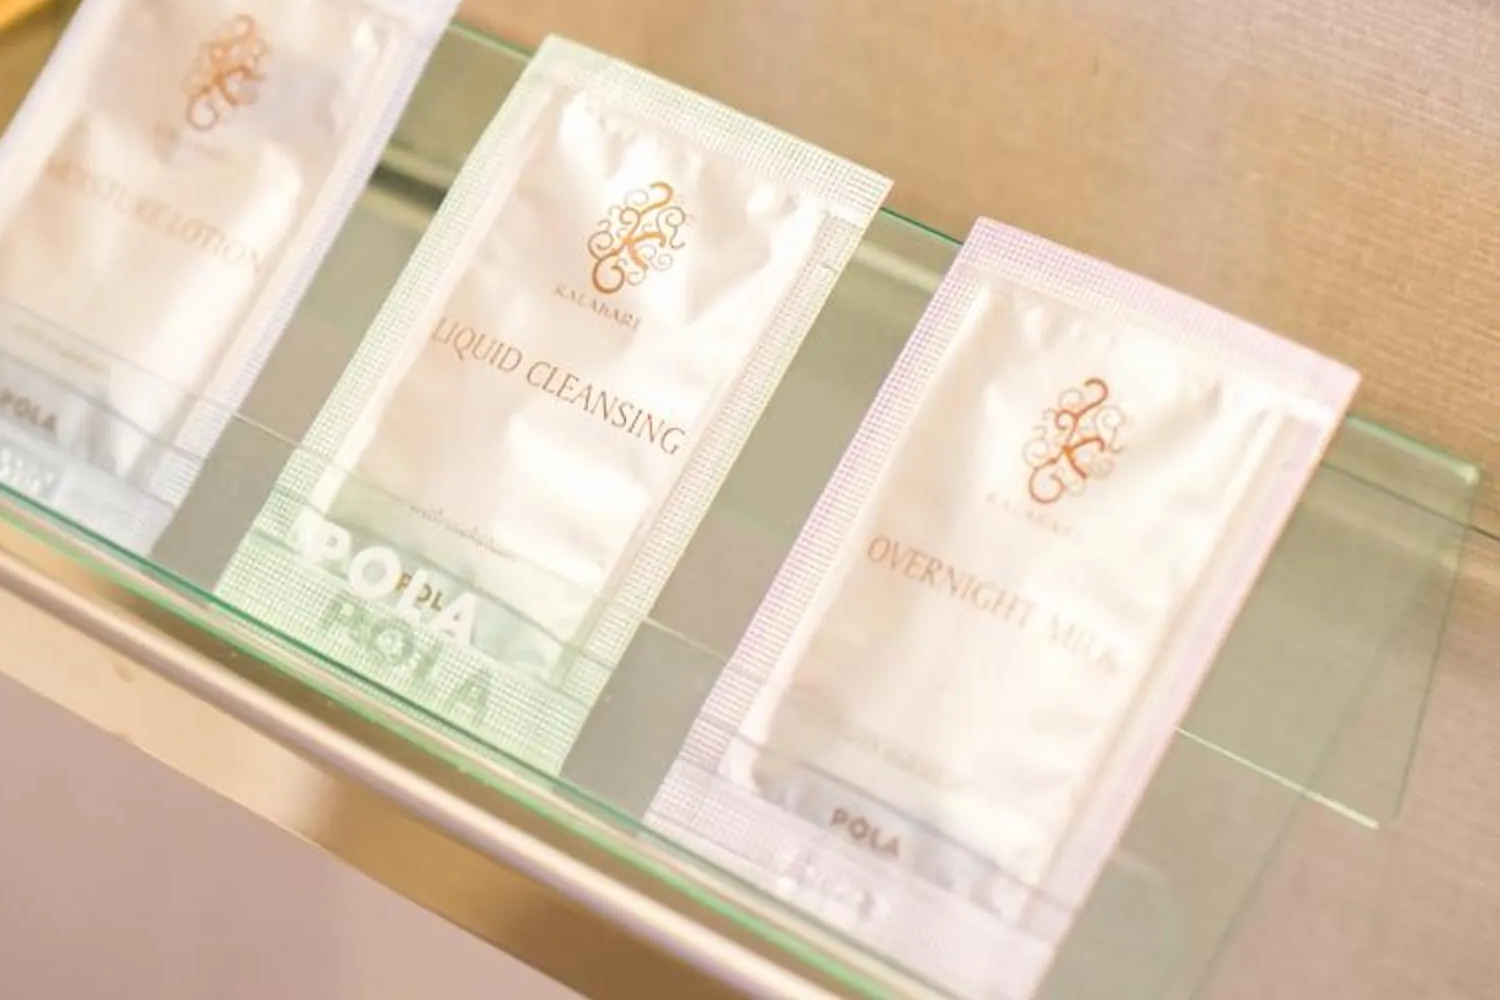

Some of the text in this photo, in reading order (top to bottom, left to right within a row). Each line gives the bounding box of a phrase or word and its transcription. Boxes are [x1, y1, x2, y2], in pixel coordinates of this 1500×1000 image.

[430, 315, 686, 455] LIQUID CLEANSING
[296, 508, 478, 647] POLA
[867, 535, 1040, 630] OVERNIGHT
[829, 807, 899, 858] POLA
